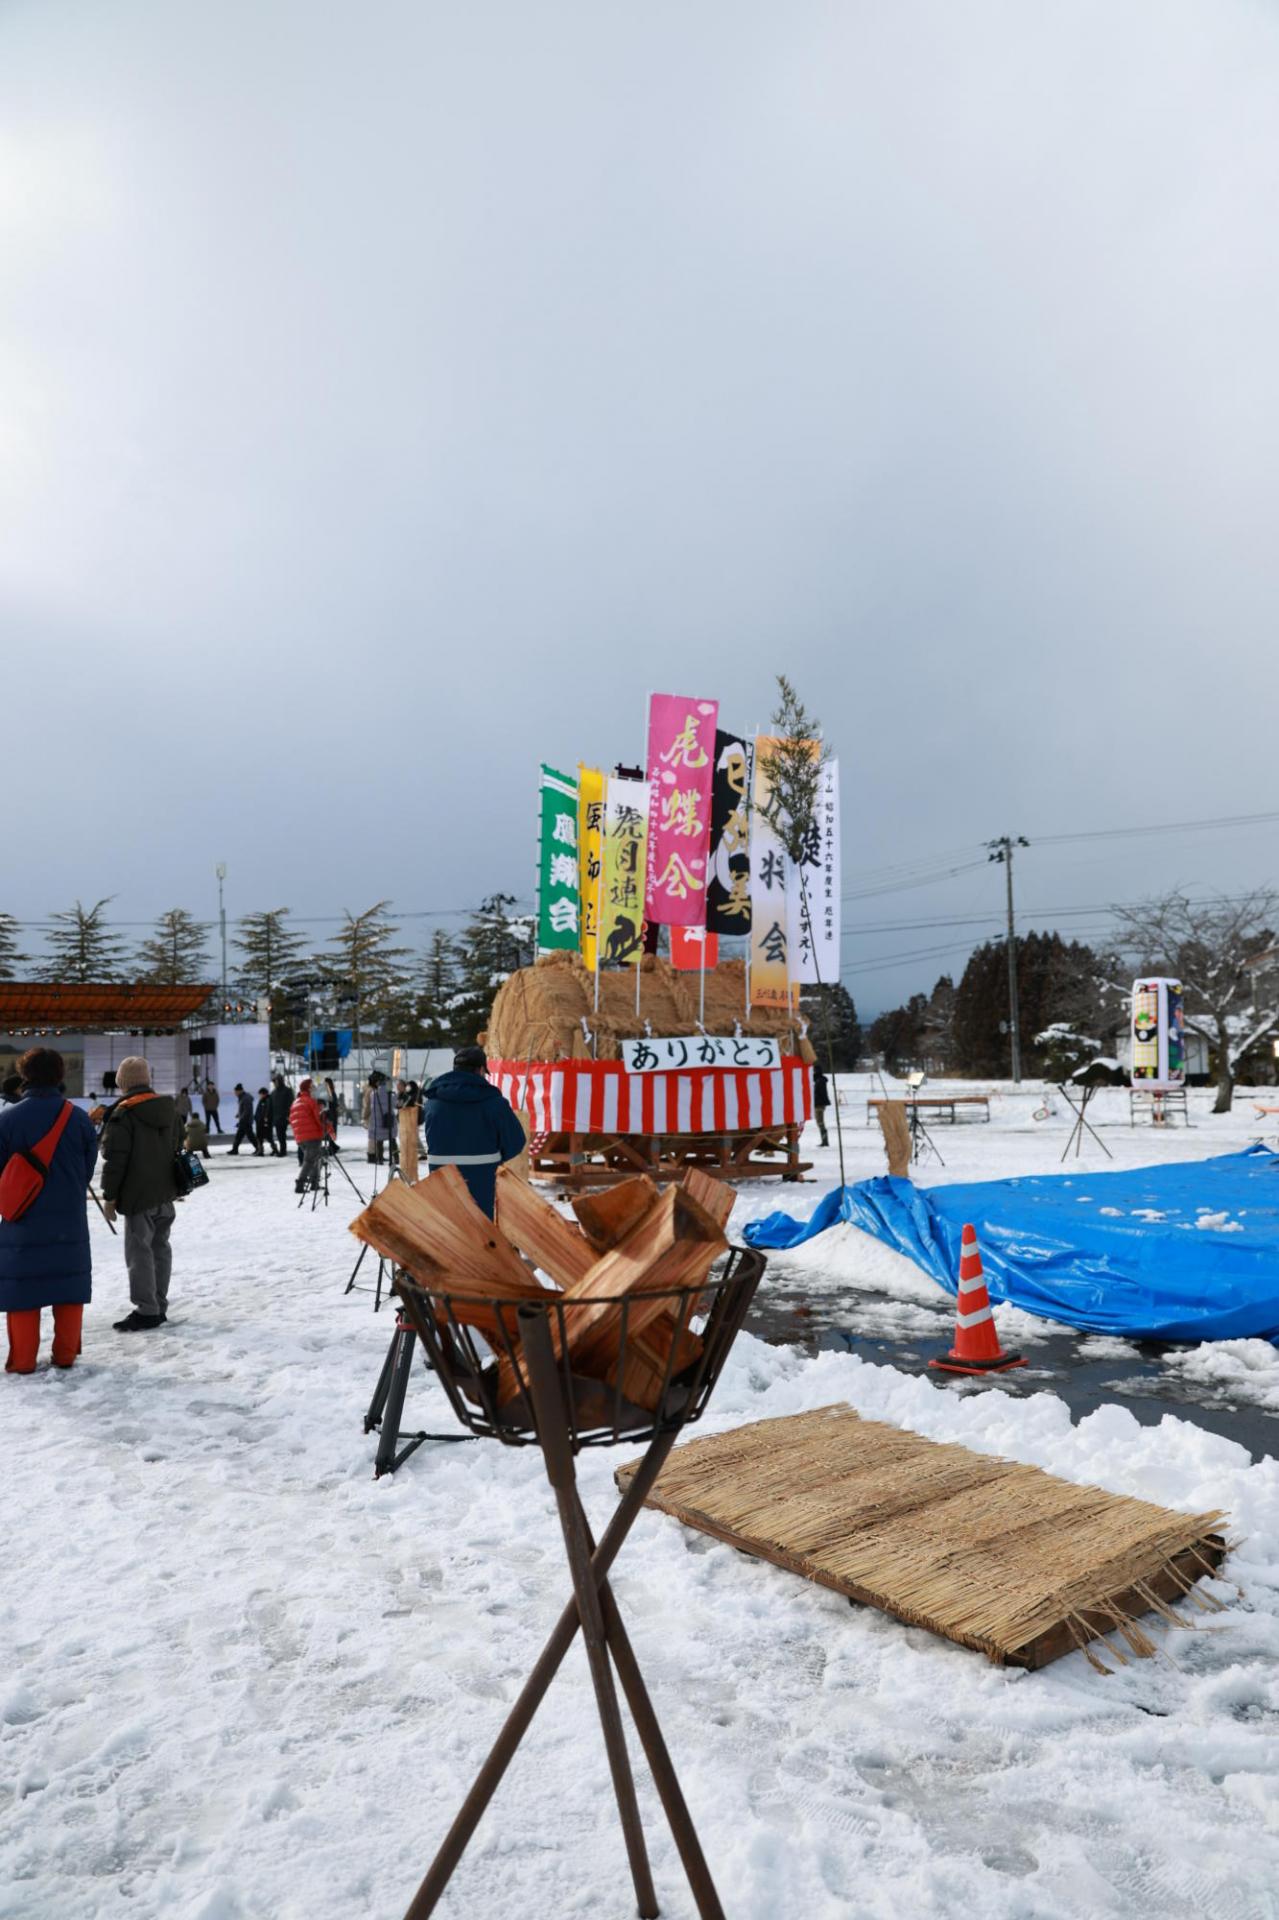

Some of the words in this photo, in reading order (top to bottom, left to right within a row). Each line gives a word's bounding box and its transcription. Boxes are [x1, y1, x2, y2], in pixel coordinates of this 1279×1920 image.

[631, 1040, 775, 1070] ありがとう
